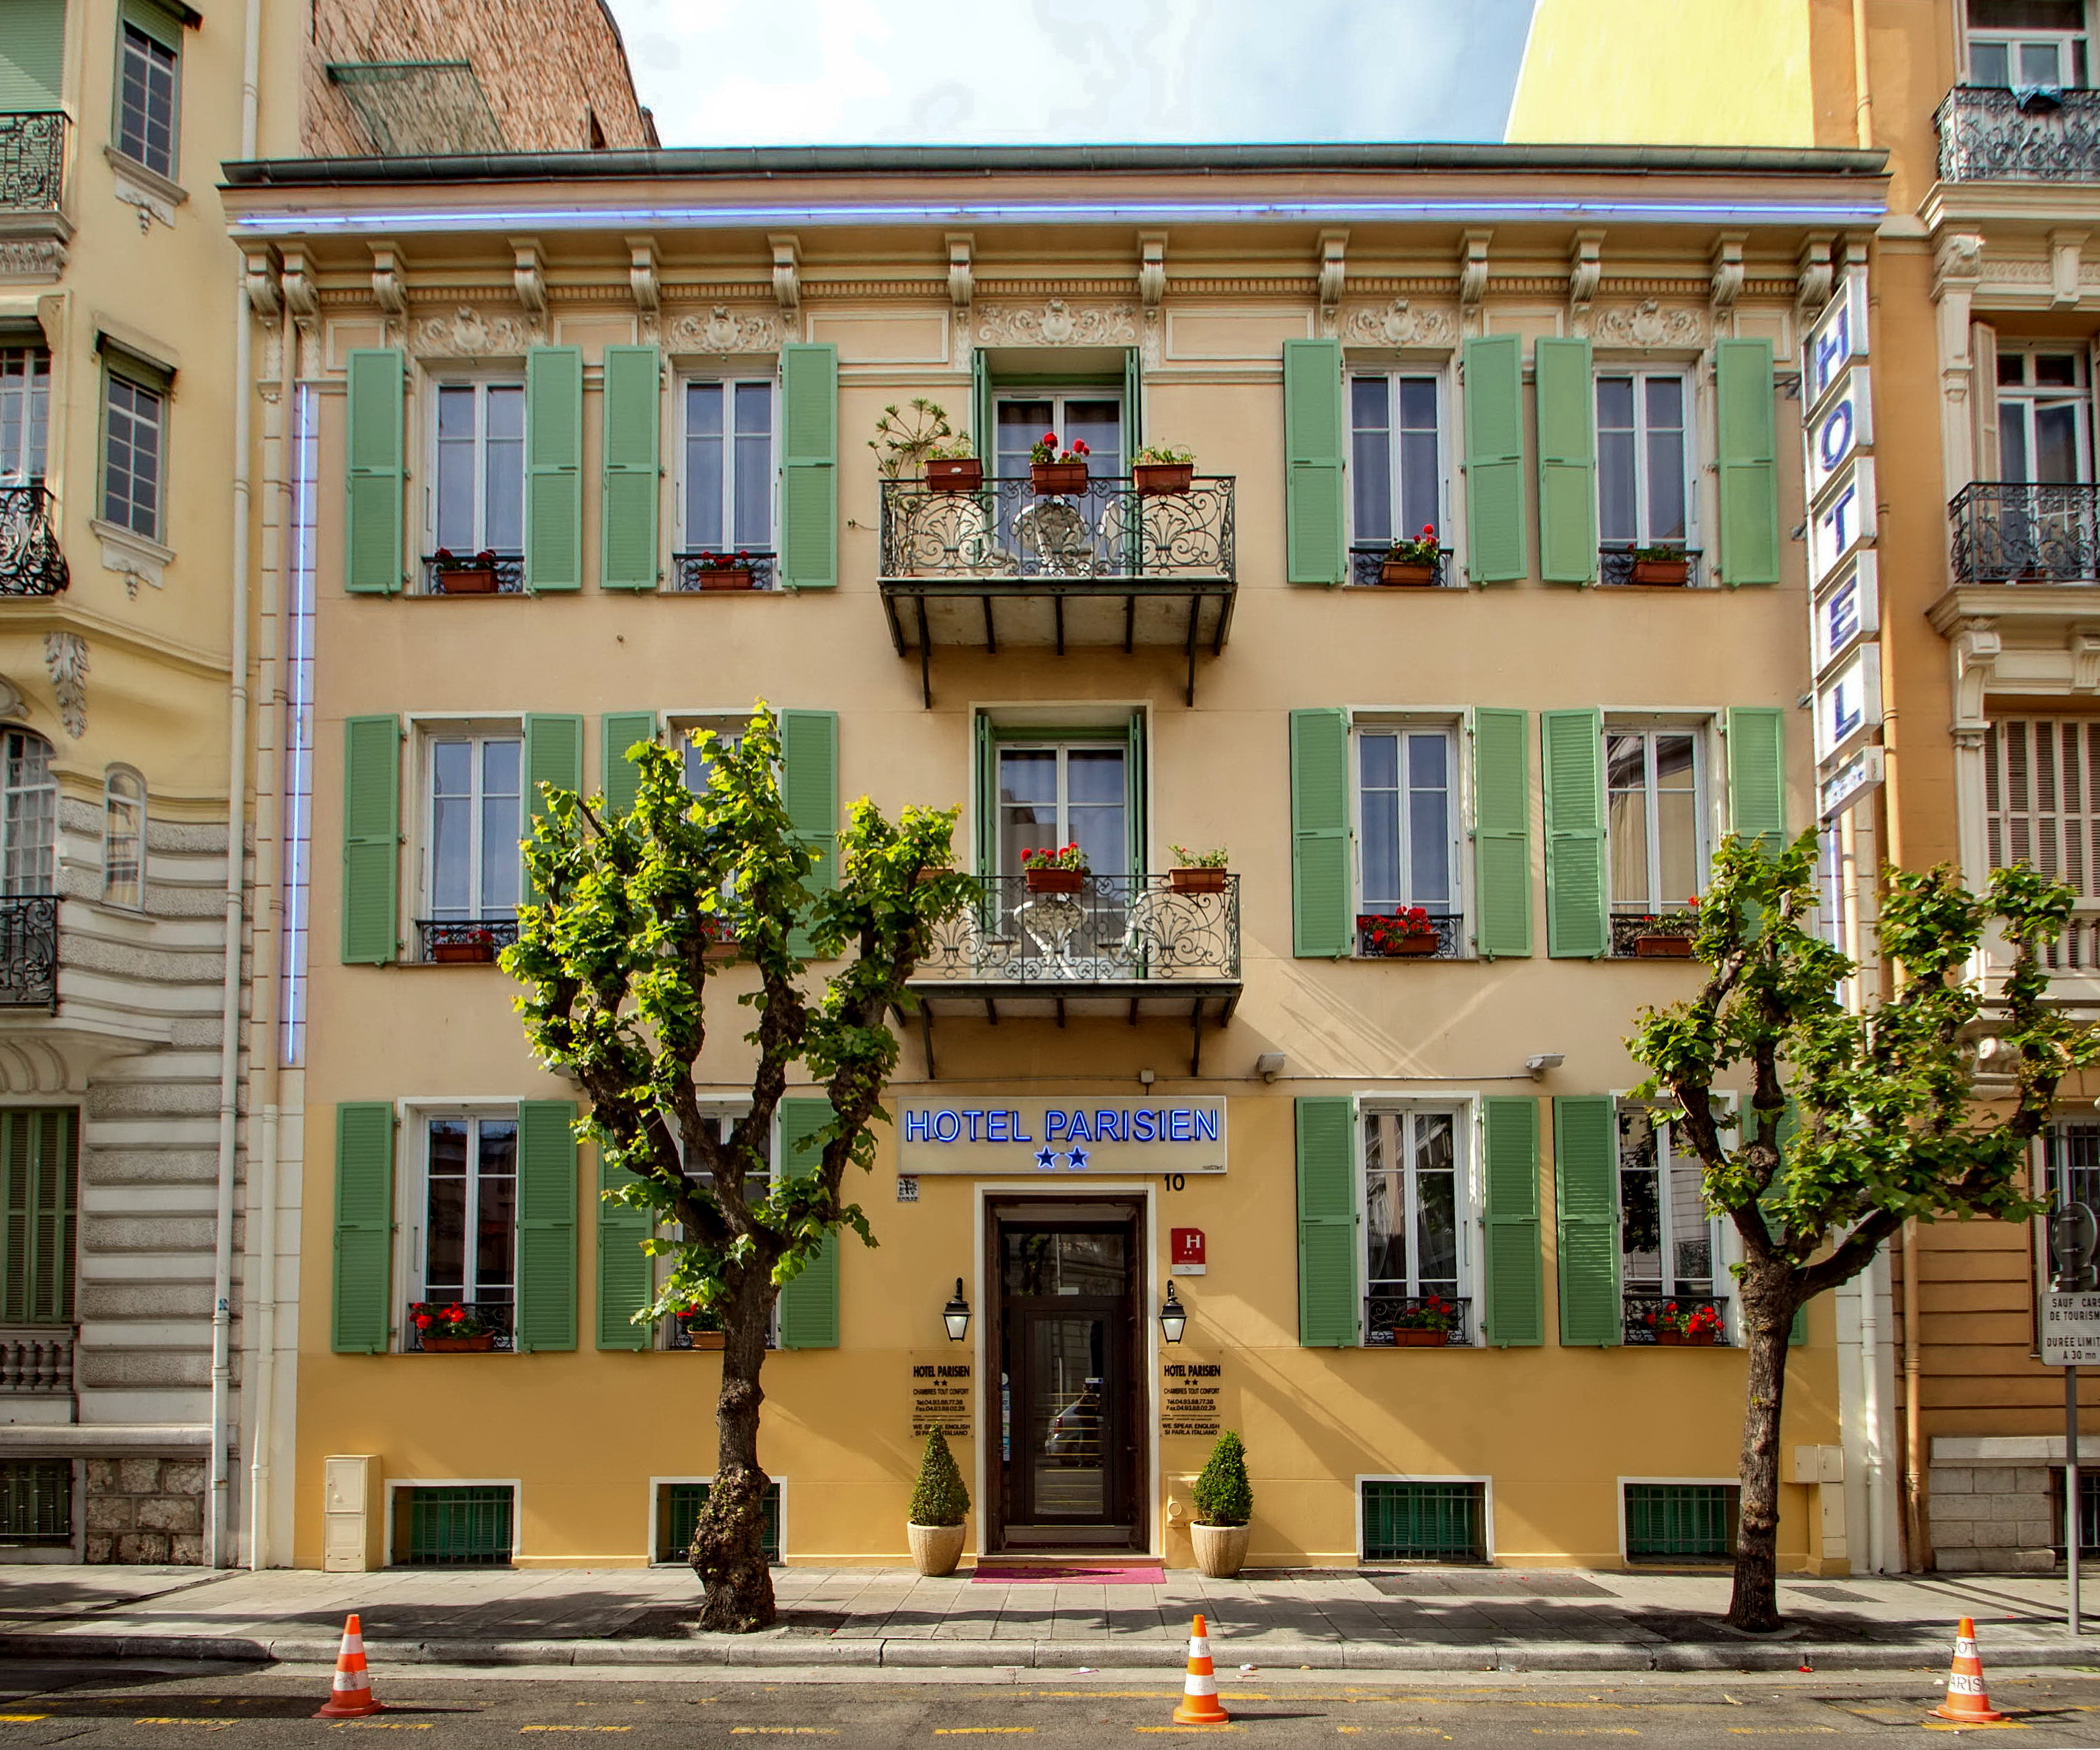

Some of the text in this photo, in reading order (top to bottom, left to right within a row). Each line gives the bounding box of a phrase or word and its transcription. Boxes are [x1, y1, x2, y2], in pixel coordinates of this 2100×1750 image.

[1815, 296, 1862, 744] HOTEL
[906, 1108, 1219, 1143] HOTEL PARISIEN
[1163, 1173, 1186, 1192] 10
[1186, 1234, 1201, 1249] H
[2052, 1297, 2074, 1308] SAUF
[2049, 1311, 2060, 1321] DE
[2046, 1335, 2074, 1347] DURÉE
[2063, 1350, 2068, 1360] A
[2071, 1350, 2082, 1360] 30
[913, 1365, 971, 1378] HOTEL PARISIEN
[1164, 1364, 1221, 1377] HOTEL PARISIEN
[913, 1388, 936, 1396] CHAMBRES
